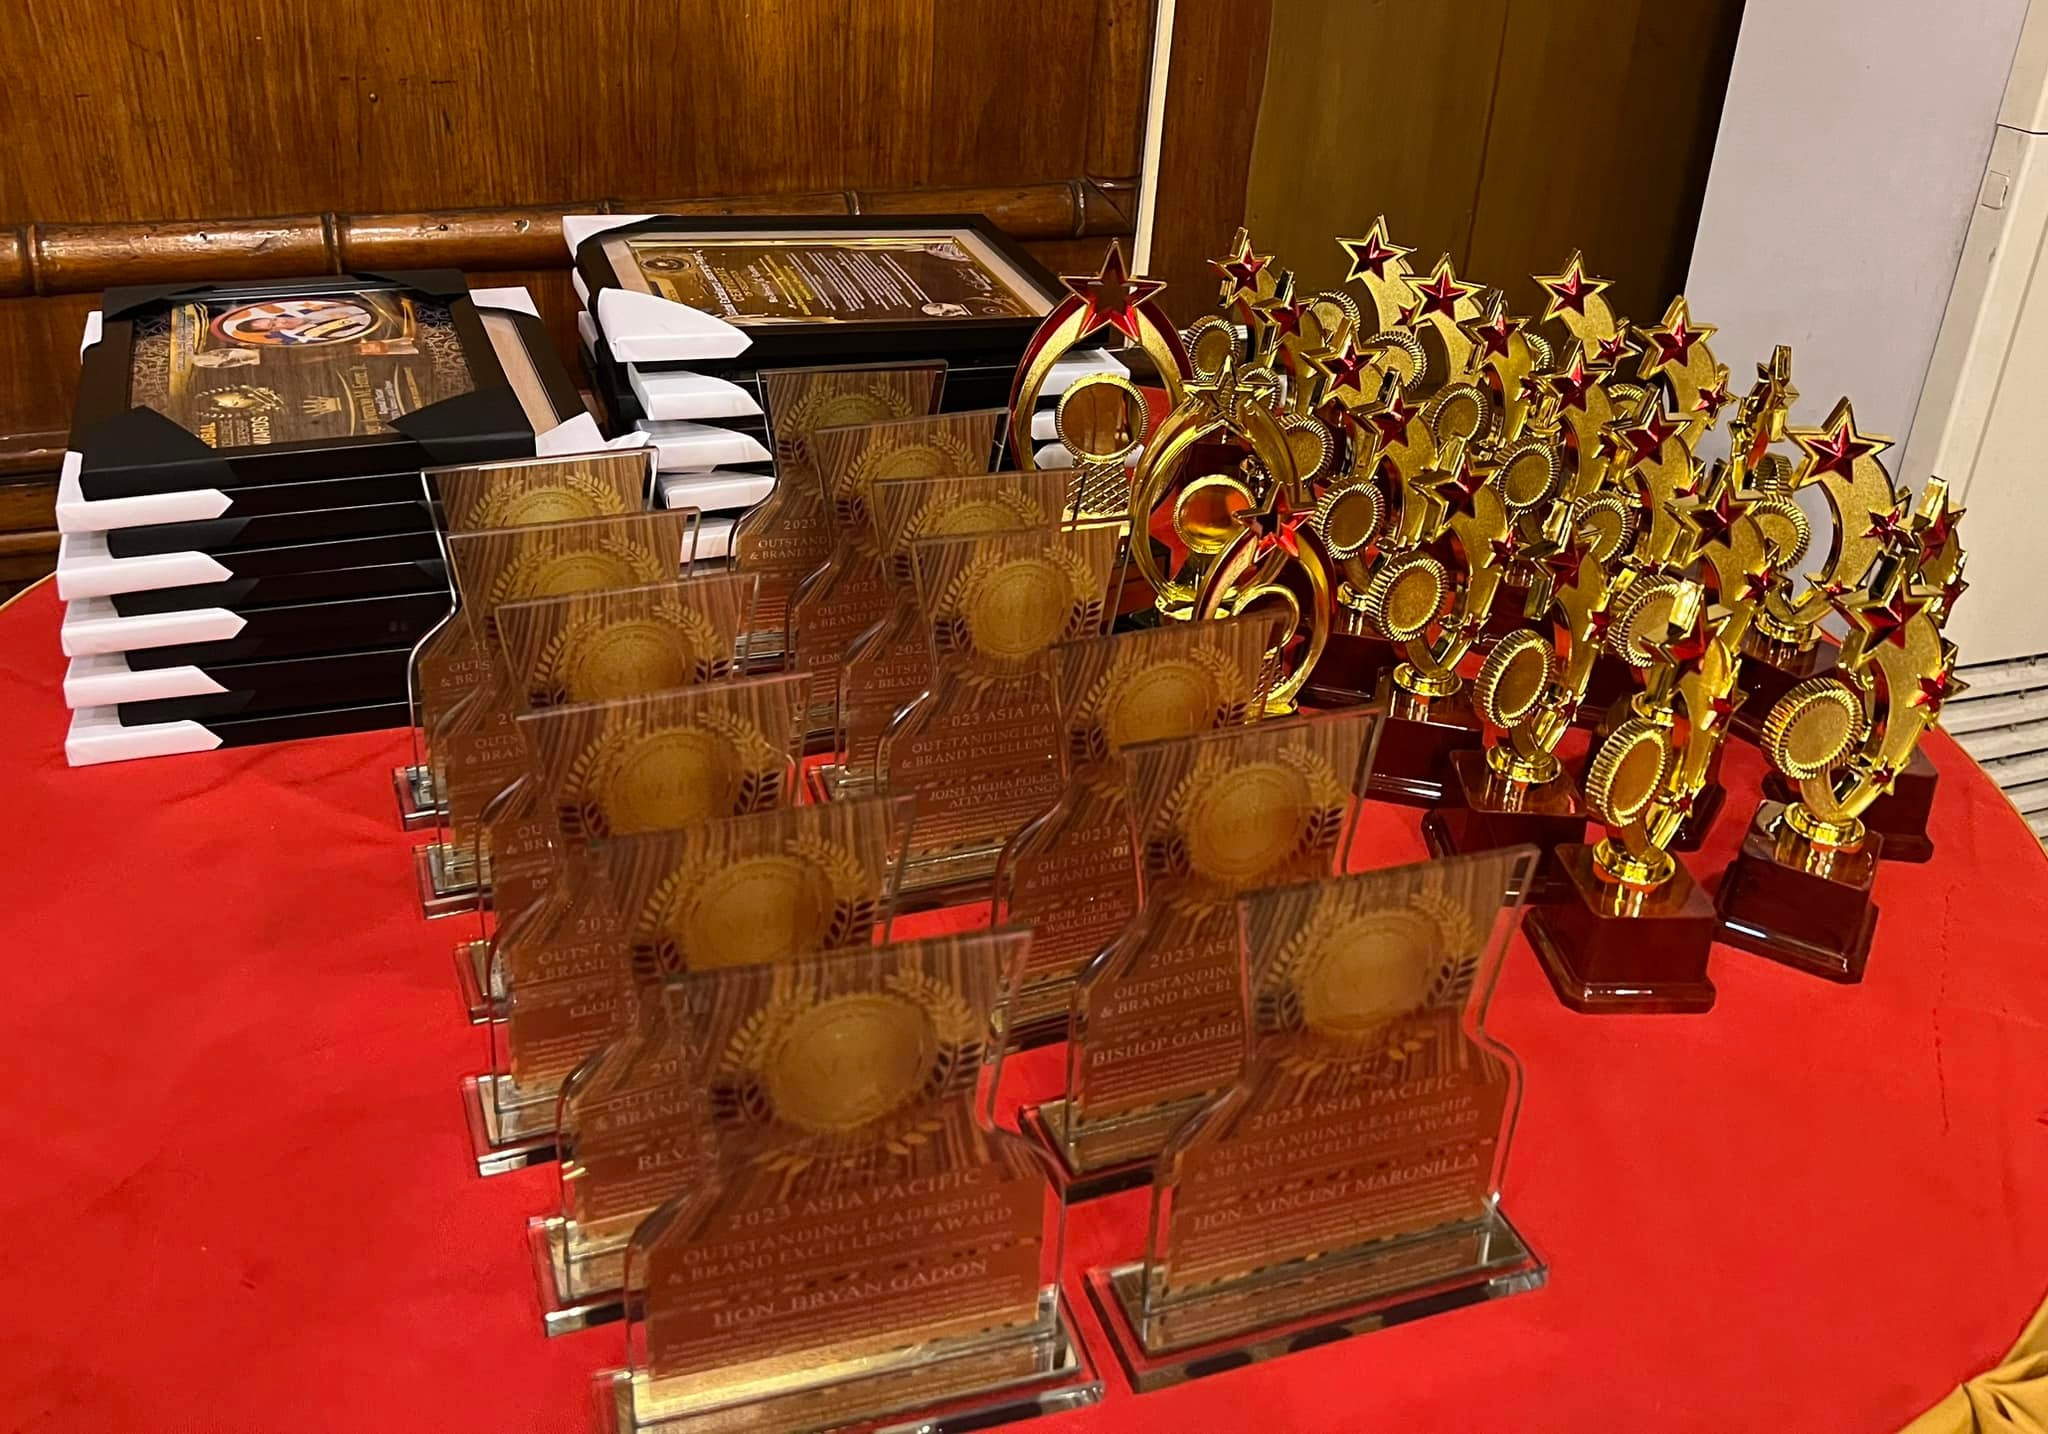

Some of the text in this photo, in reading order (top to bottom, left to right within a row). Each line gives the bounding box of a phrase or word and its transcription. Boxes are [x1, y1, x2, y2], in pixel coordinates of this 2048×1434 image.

[986, 706, 1025, 723] ASIA
[1031, 702, 1052, 716] PA
[911, 729, 1020, 754] OUTSTANDING
[902, 759, 912, 770] &
[915, 748, 968, 768] BRAND
[929, 786, 966, 802] JOINT
[1071, 825, 1112, 846] 2023
[1041, 866, 1095, 887] BRAND
[1149, 946, 1195, 969] 2023
[1100, 1007, 1113, 1019] &
[1117, 991, 1179, 1015] BRAND
[1183, 979, 1233, 999] EXCEL
[1091, 1037, 1168, 1067] BISHOP
[1252, 1073, 1460, 1130] 2023 ASIA PACIFIC
[1209, 1121, 1352, 1162] OUTSTANDING
[1356, 1096, 1474, 1132] LEADERSHIP
[1213, 1152, 1278, 1178] BRAND
[1286, 1127, 1402, 1161] EXCELLENCE
[1411, 1109, 1480, 1136] AWARD
[730, 1167, 983, 1231] 2023 ASIA PACIFIC
[1255, 1181, 1351, 1213] VINCENT
[667, 1271, 685, 1284] &
[690, 1255, 774, 1281] BRAND
[778, 1224, 922, 1263] EXCELLENCE
[929, 1205, 1014, 1234] AWARD
[682, 1223, 857, 1266] OUTSTANDING
[860, 1191, 1003, 1230] LEADERSHIP
[790, 1281, 884, 1312] BRYAN
[888, 1259, 989, 1288] GADON
